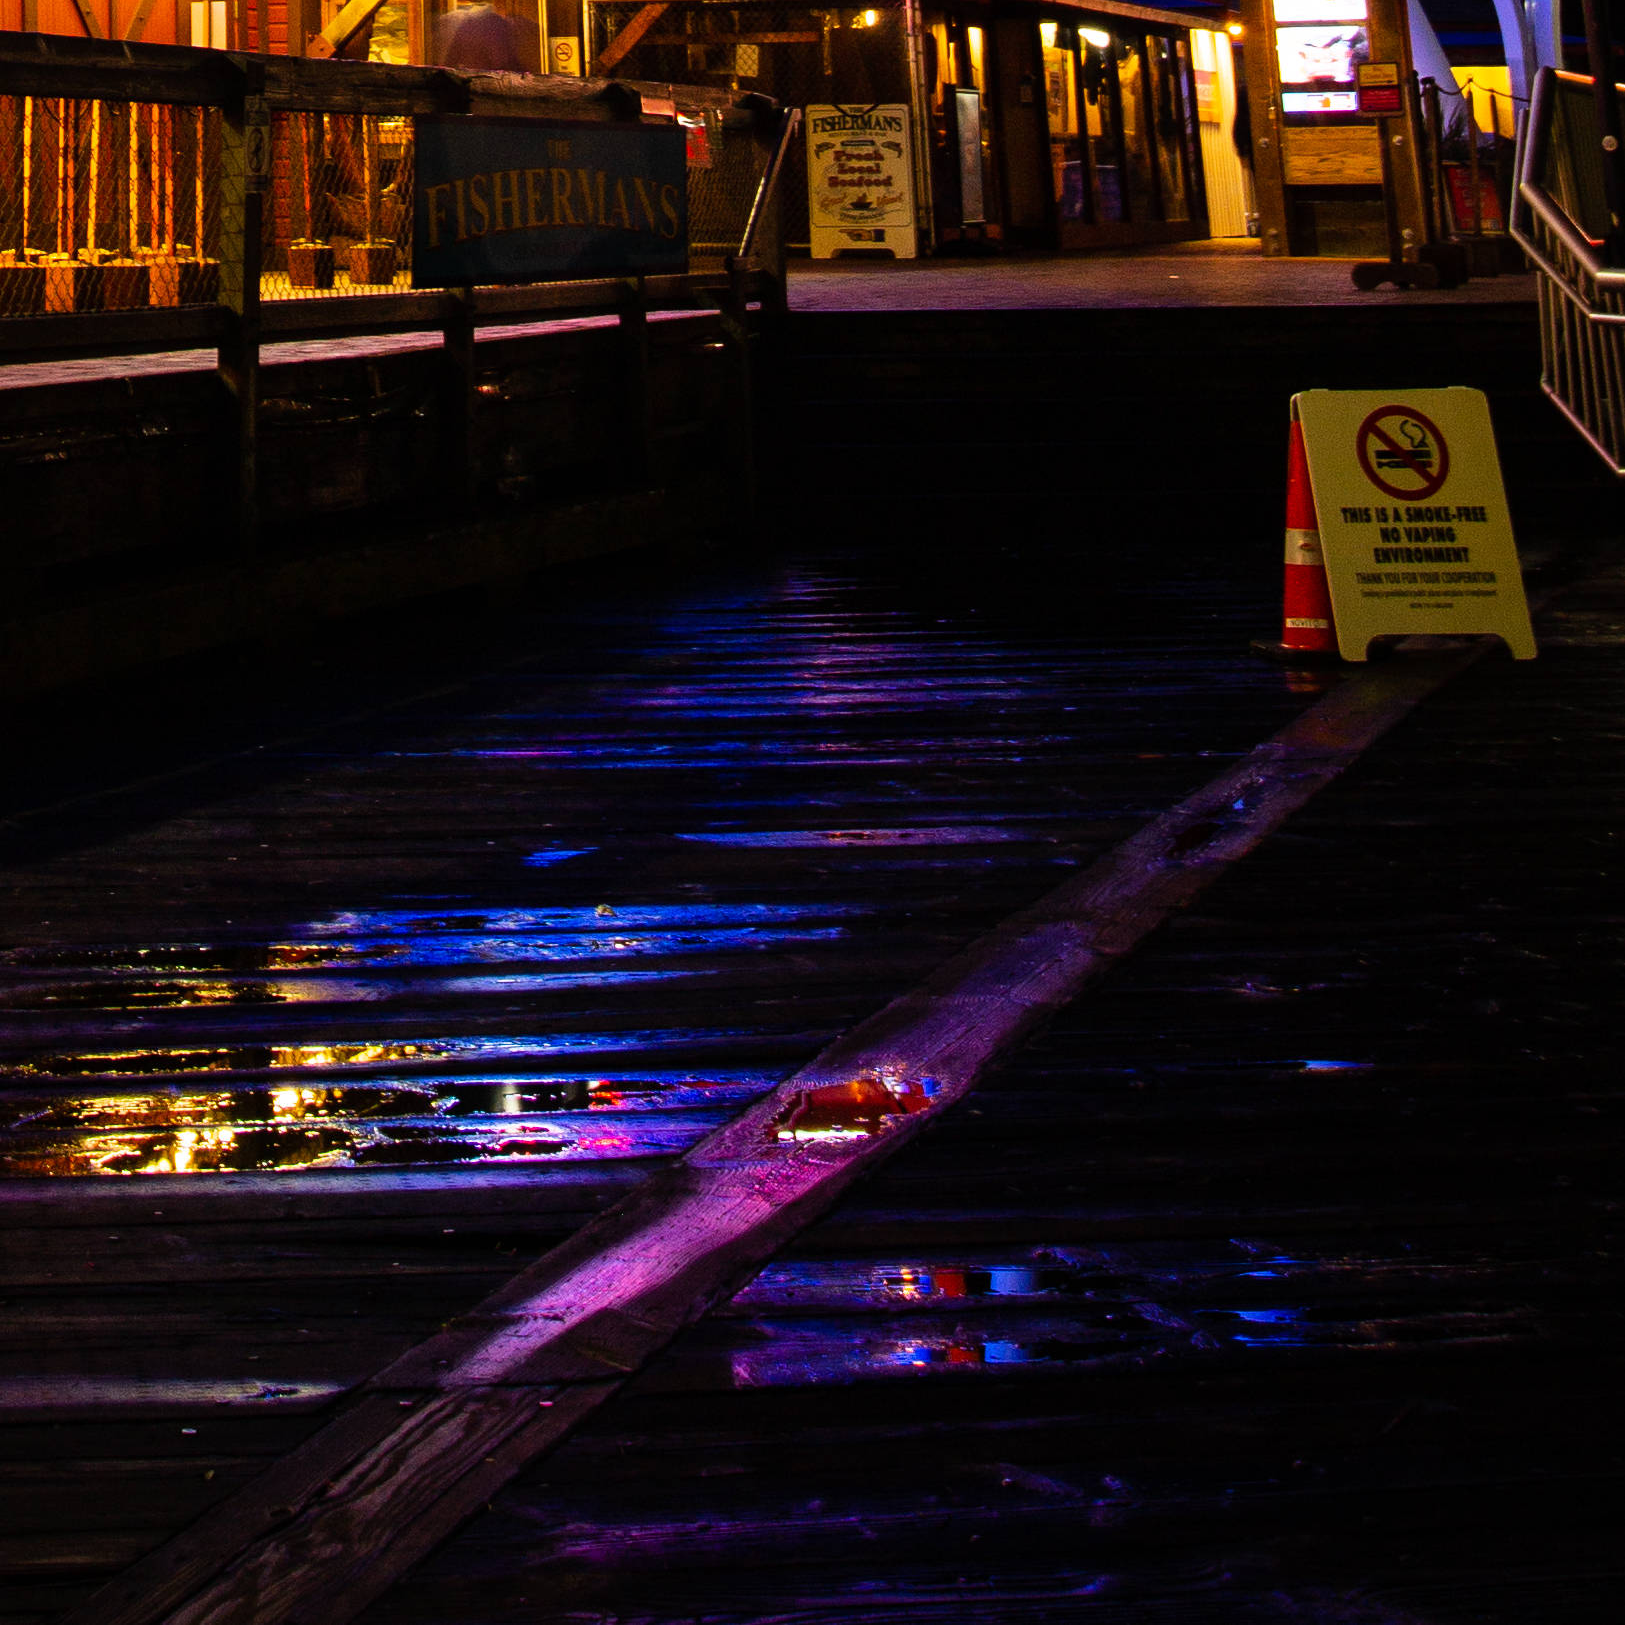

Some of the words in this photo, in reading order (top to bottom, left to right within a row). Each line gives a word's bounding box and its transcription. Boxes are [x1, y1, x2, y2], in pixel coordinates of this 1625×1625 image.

[547, 138, 573, 160] THE
[833, 149, 885, 162] Fresh
[837, 162, 881, 175] Local
[828, 175, 893, 188] Seafood
[424, 167, 680, 251] FISHERMANS
[1340, 506, 1372, 524] THIS
[1375, 506, 1389, 523] IS
[1392, 506, 1403, 523] A
[1405, 505, 1488, 523] SMOKE-FREE
[1379, 526, 1401, 544] NO
[1403, 526, 1457, 543] VAPING
[1373, 547, 1470, 564] ENVIRONMENT
